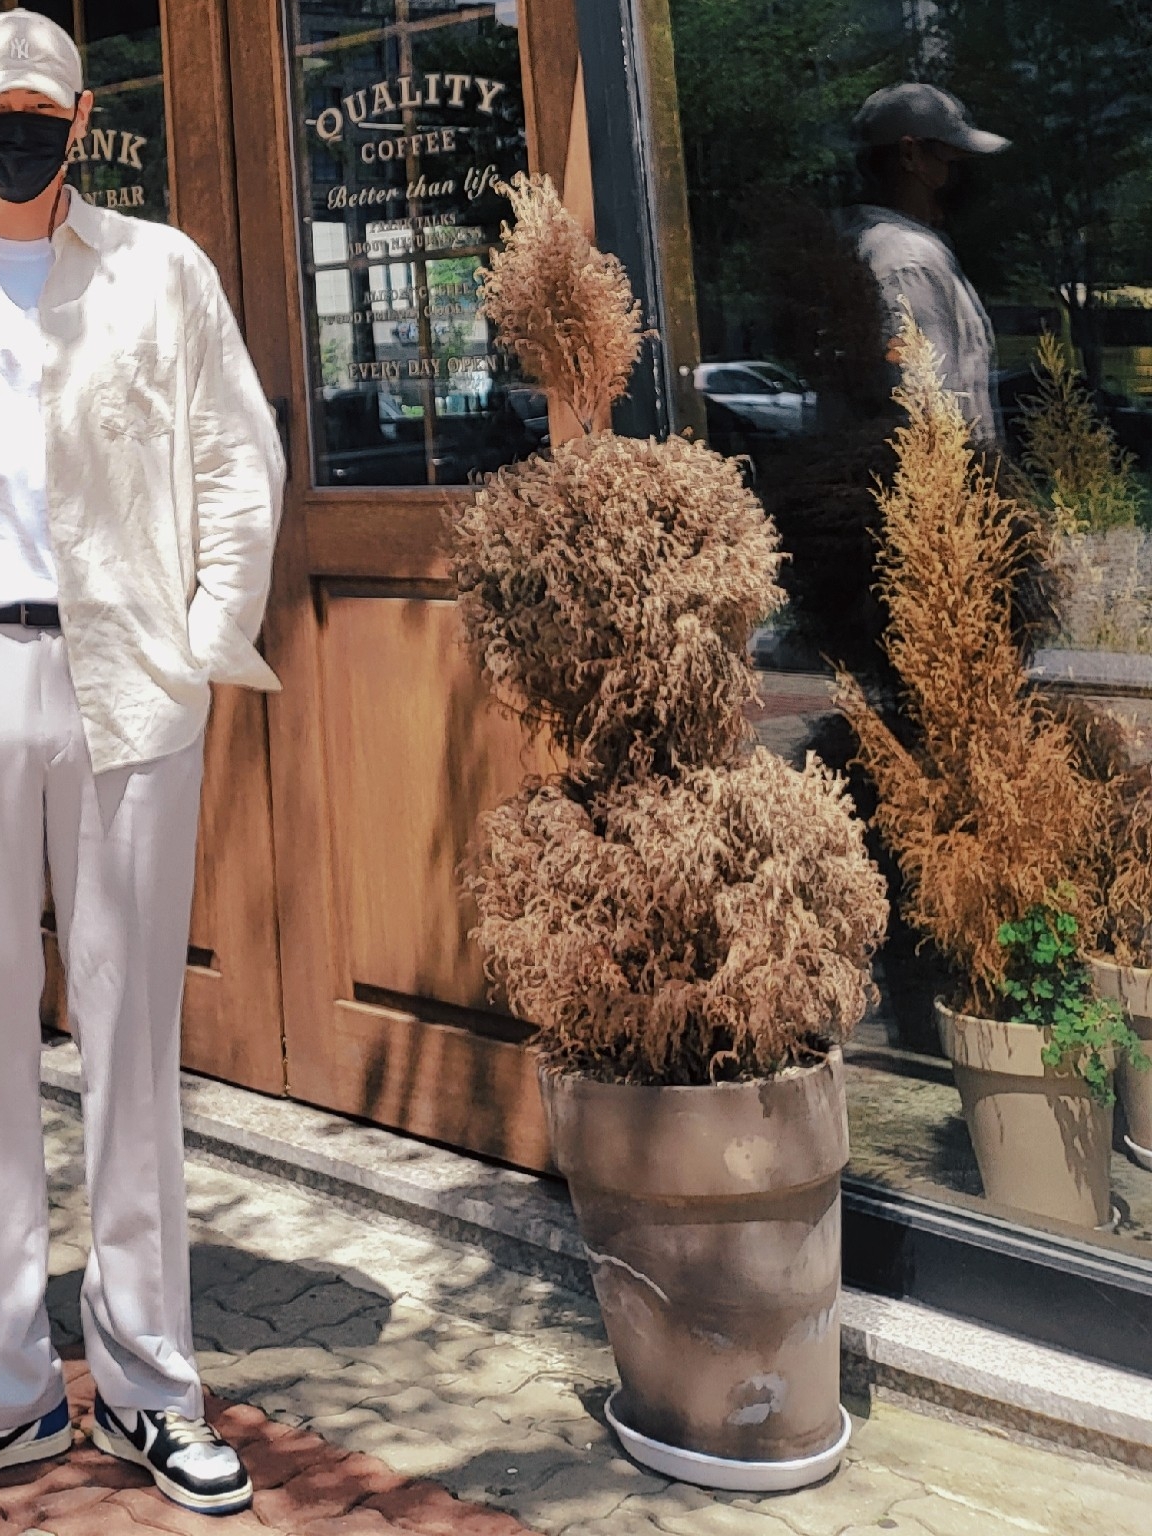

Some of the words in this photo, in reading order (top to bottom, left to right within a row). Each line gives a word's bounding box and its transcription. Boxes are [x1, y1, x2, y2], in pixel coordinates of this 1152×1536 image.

[315, 73, 506, 142] QUALITY
[361, 129, 456, 164] COFFEE
[107, 185, 145, 208] BAR
[327, 185, 398, 211] Better
[406, 174, 456, 200] than
[349, 360, 400, 380] EVERY
[408, 358, 441, 377] DAY
